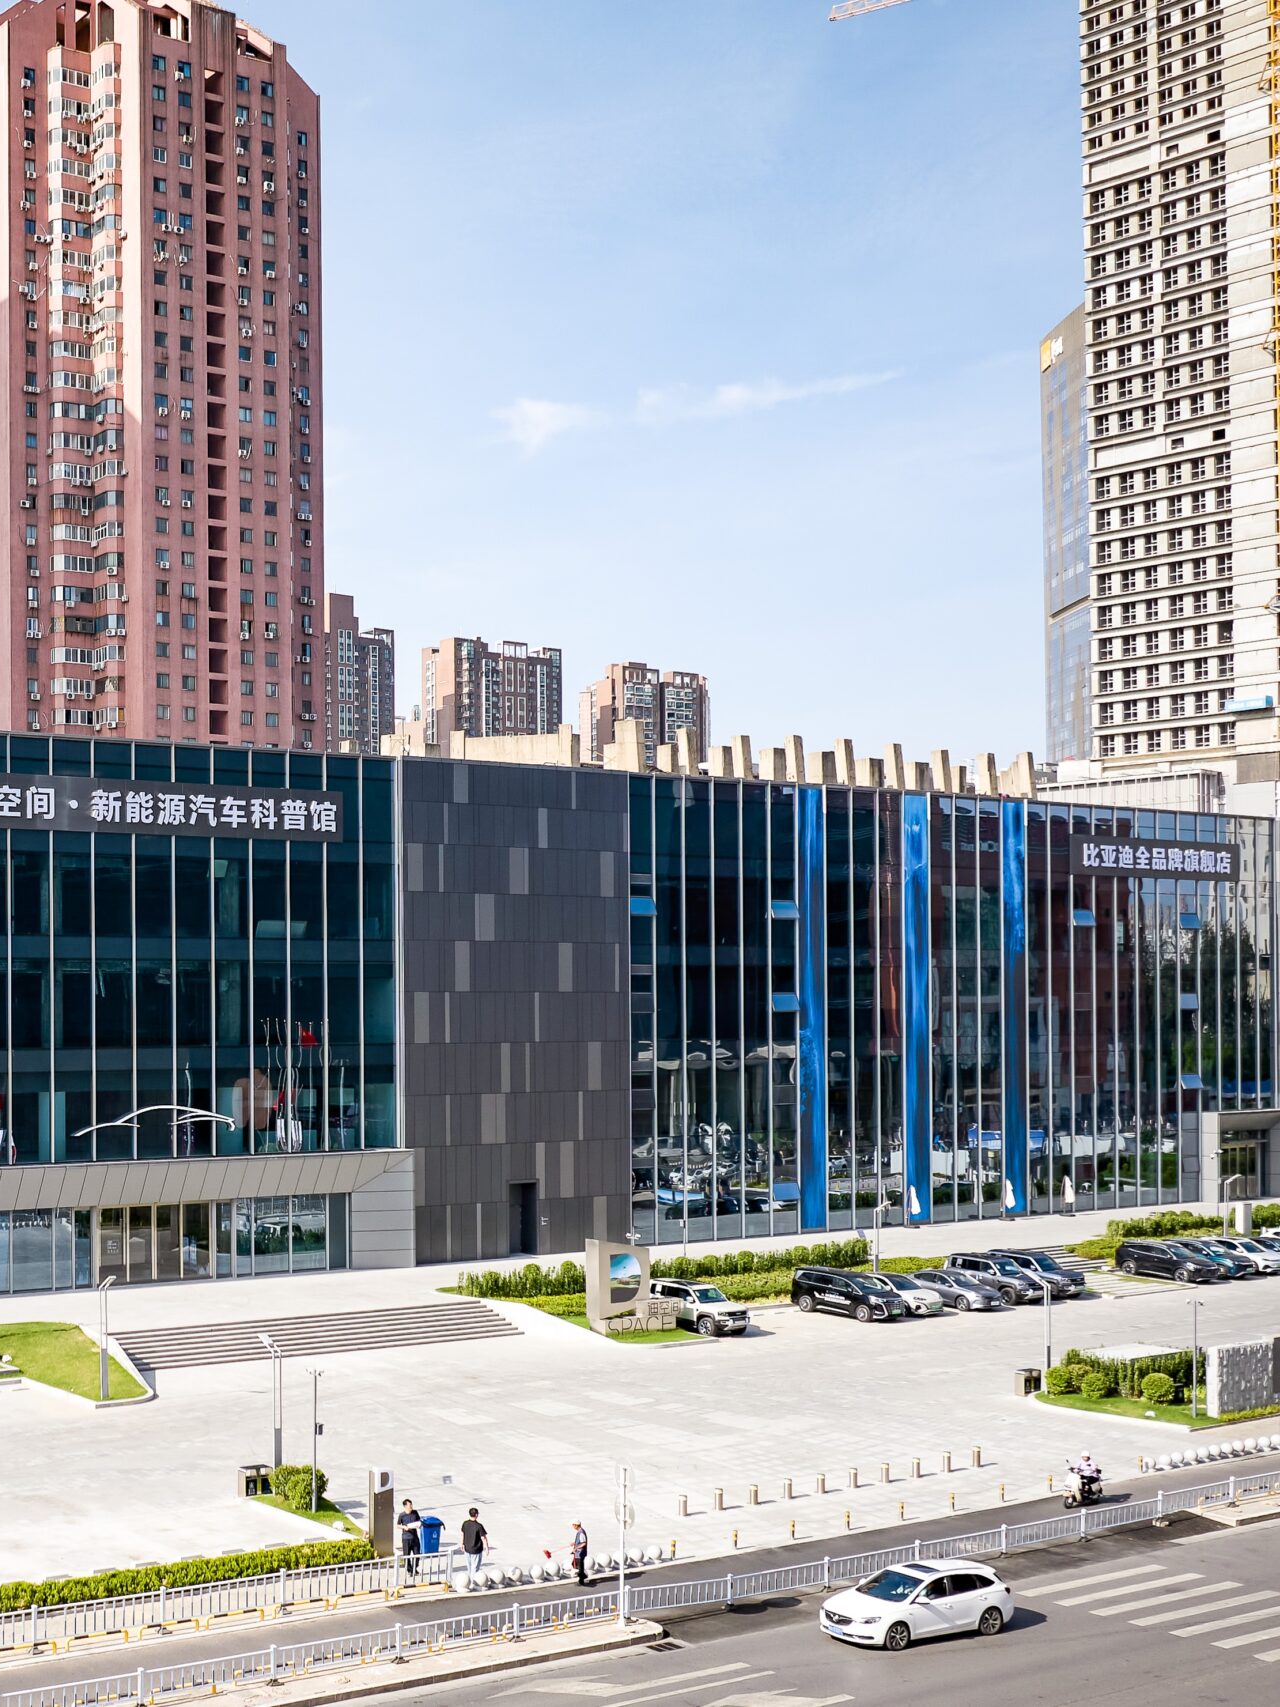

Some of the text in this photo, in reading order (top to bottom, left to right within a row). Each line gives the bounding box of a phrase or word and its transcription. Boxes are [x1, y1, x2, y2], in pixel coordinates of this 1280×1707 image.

[1082, 843, 1232, 874] 比亚迪全品牌旗舰店
[647, 1300, 681, 1316] 迪空间
[608, 1315, 674, 1336] SPACE
